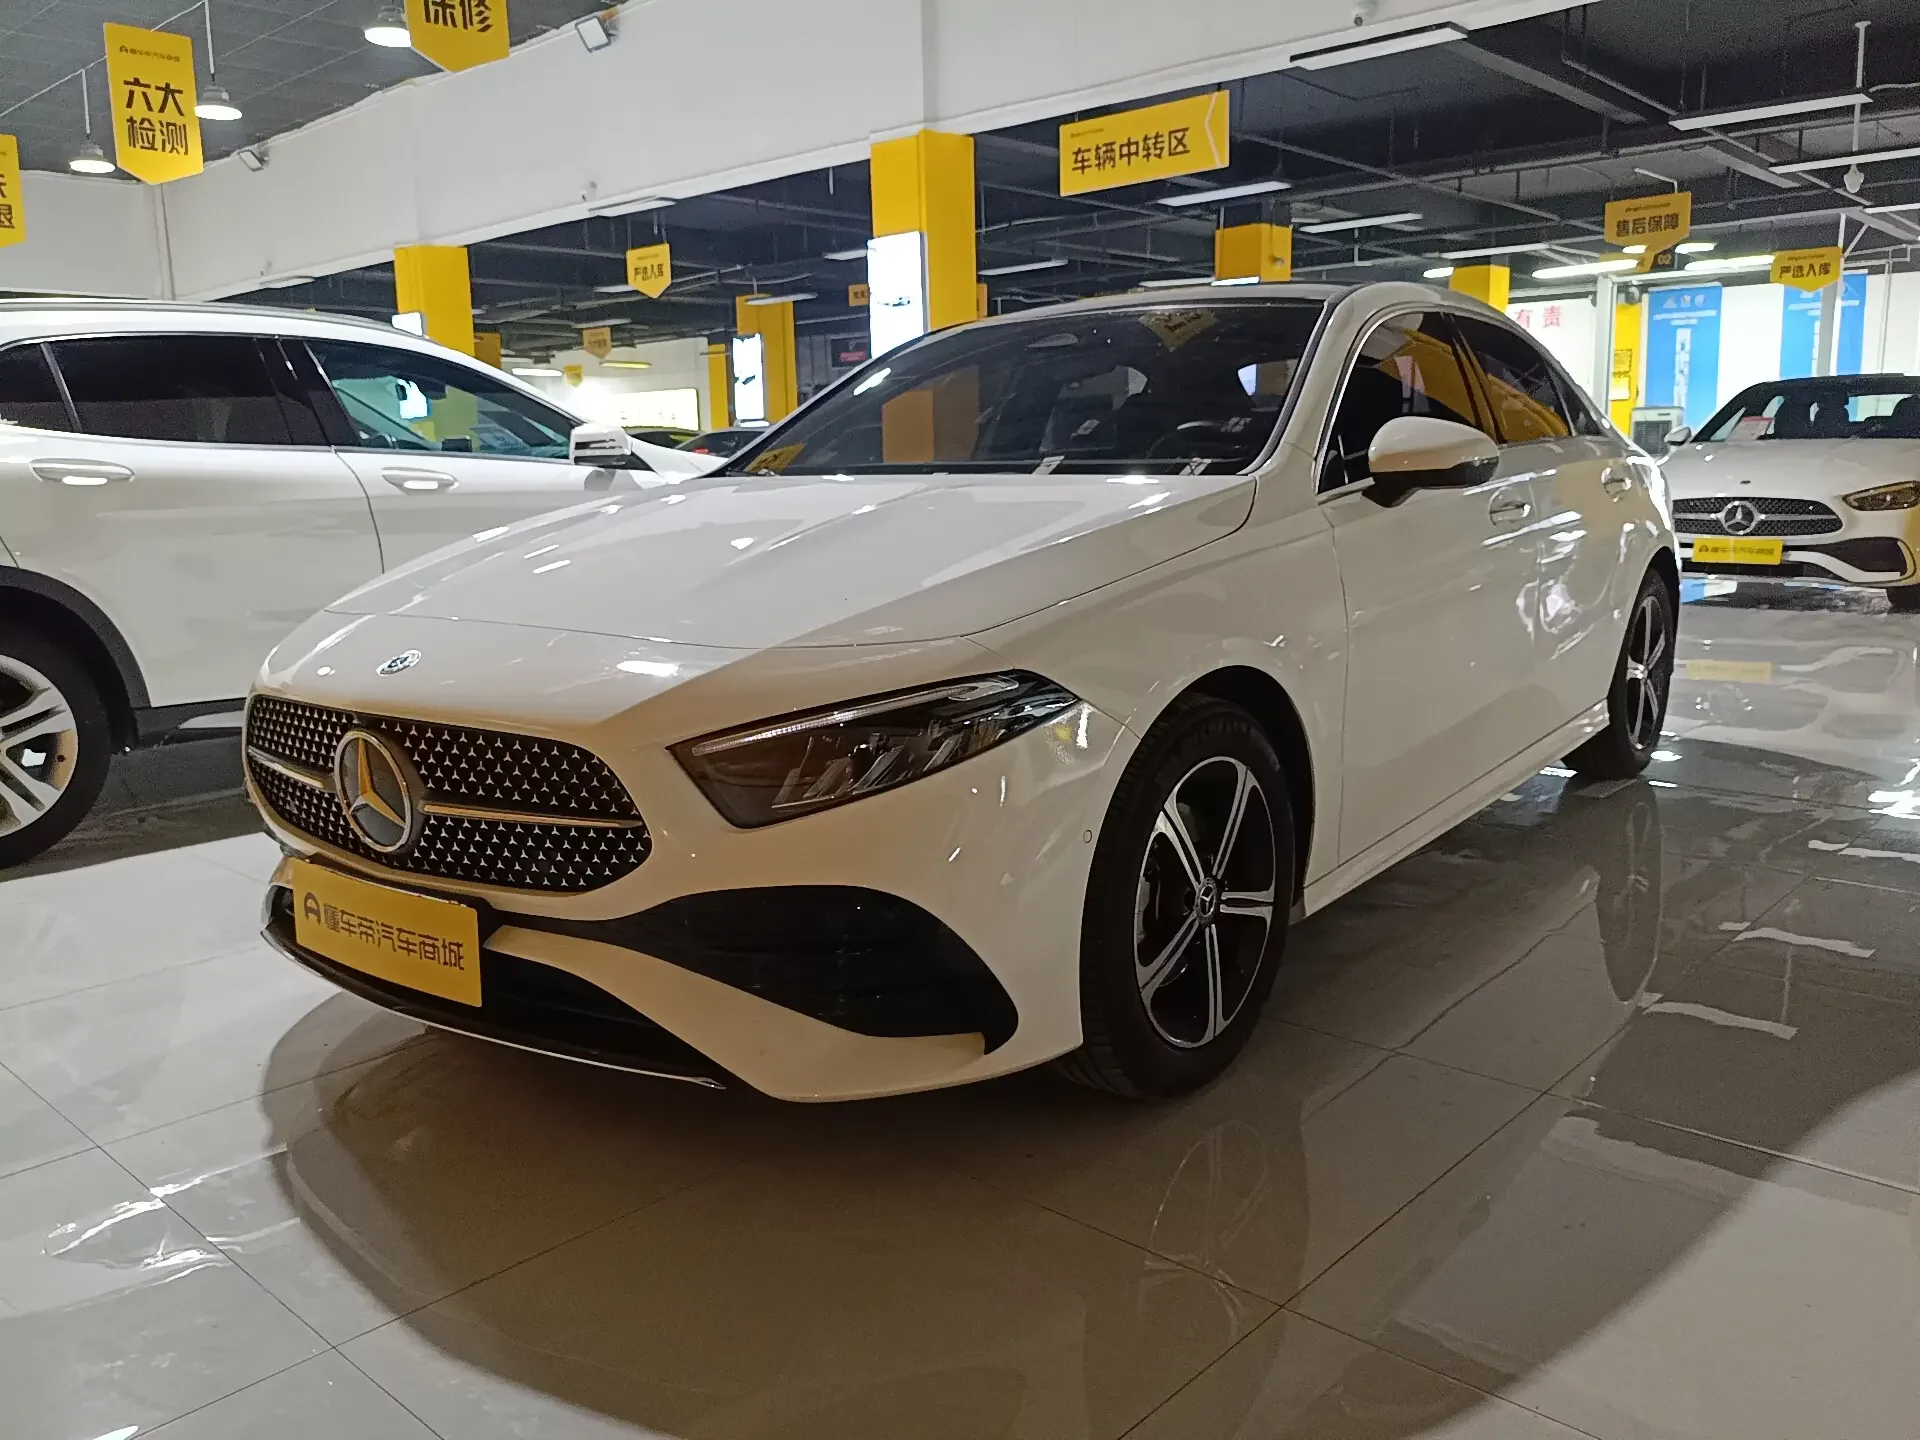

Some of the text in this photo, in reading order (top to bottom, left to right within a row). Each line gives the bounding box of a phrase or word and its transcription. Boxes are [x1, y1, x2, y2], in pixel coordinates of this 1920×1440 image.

[123, 77, 185, 117] 六大
[126, 116, 189, 155] 检测
[1072, 127, 1191, 175] 车辆中转区
[1616, 213, 1679, 237] 售后保障
[1779, 262, 1831, 279] 严选入库
[323, 902, 465, 971] 懂车帝汽车商城
